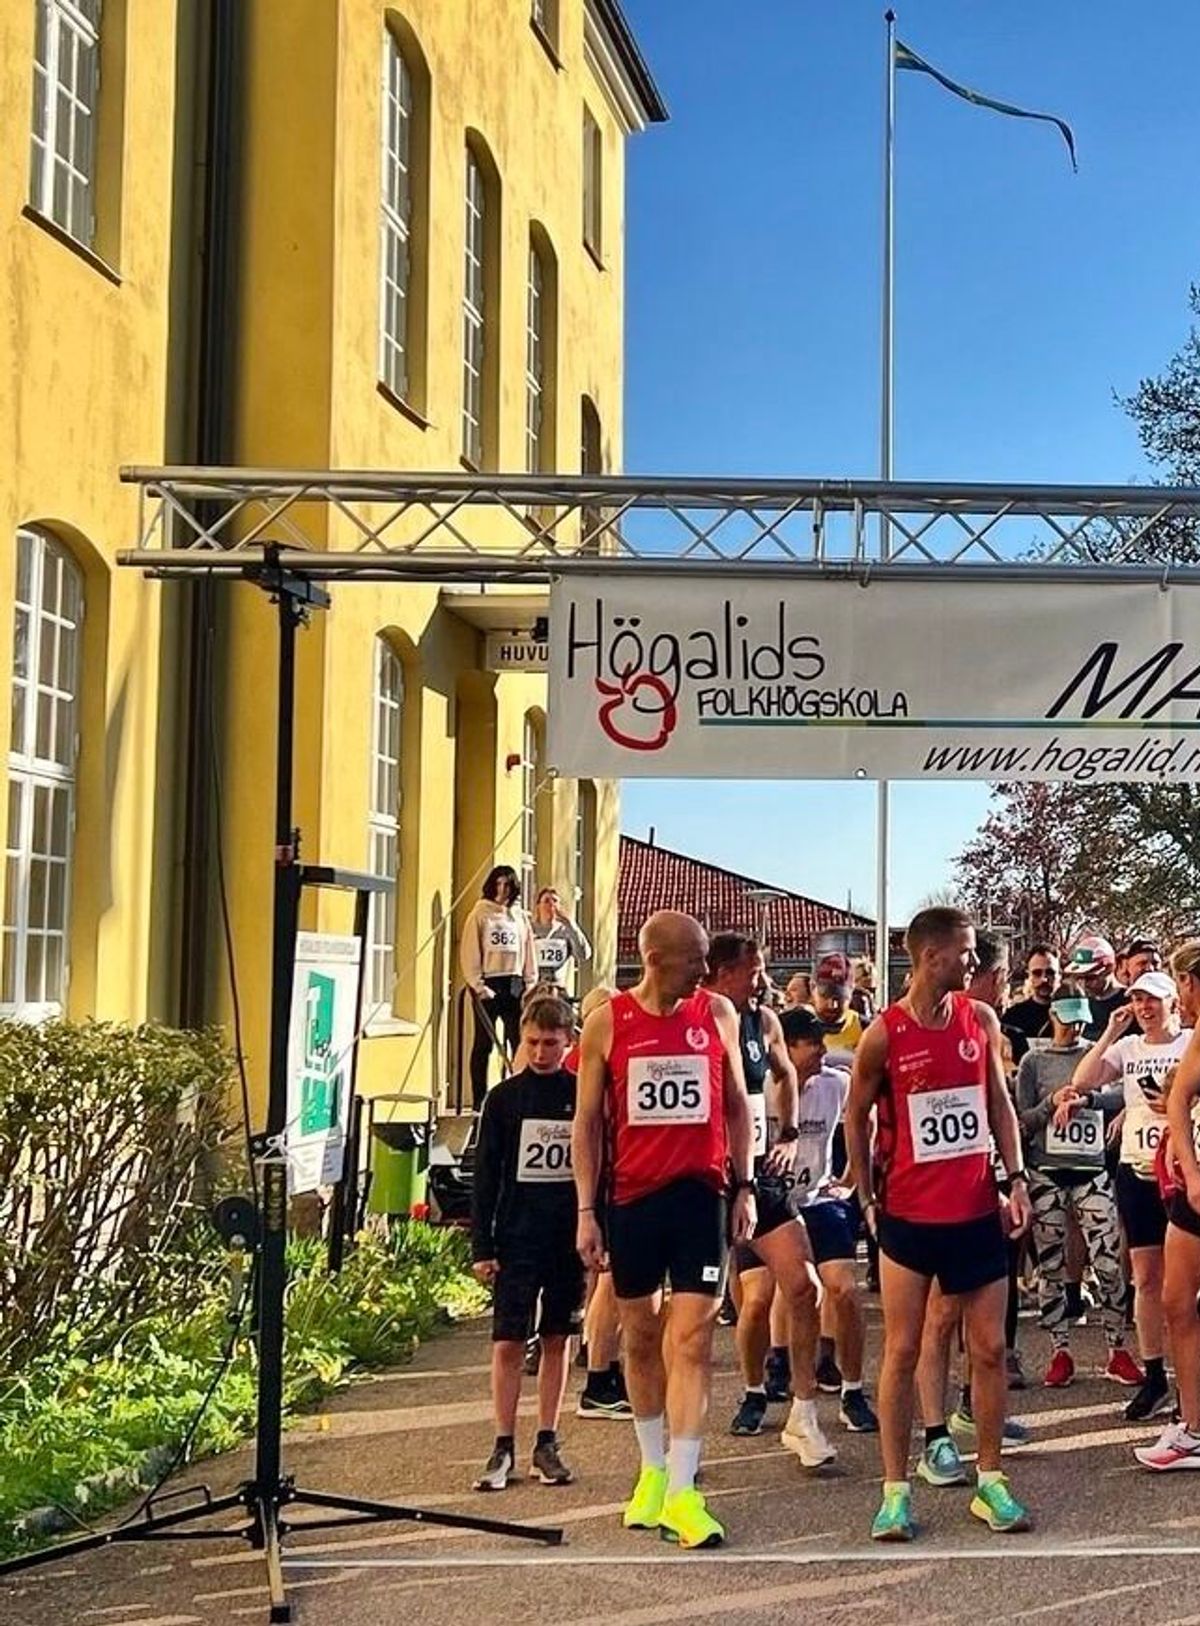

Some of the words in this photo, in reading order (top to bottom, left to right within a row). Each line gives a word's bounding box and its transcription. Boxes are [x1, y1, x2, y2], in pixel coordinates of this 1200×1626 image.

[500, 645, 549, 661] HUVU
[568, 599, 826, 713] Högalids
[699, 685, 908, 718] FOLKHÖGSKOLA
[540, 949, 563, 962] 128
[638, 1080, 701, 1111] 305
[920, 1110, 979, 1146] 309
[1054, 1122, 1097, 1145] 409
[1135, 1126, 1160, 1149] 16
